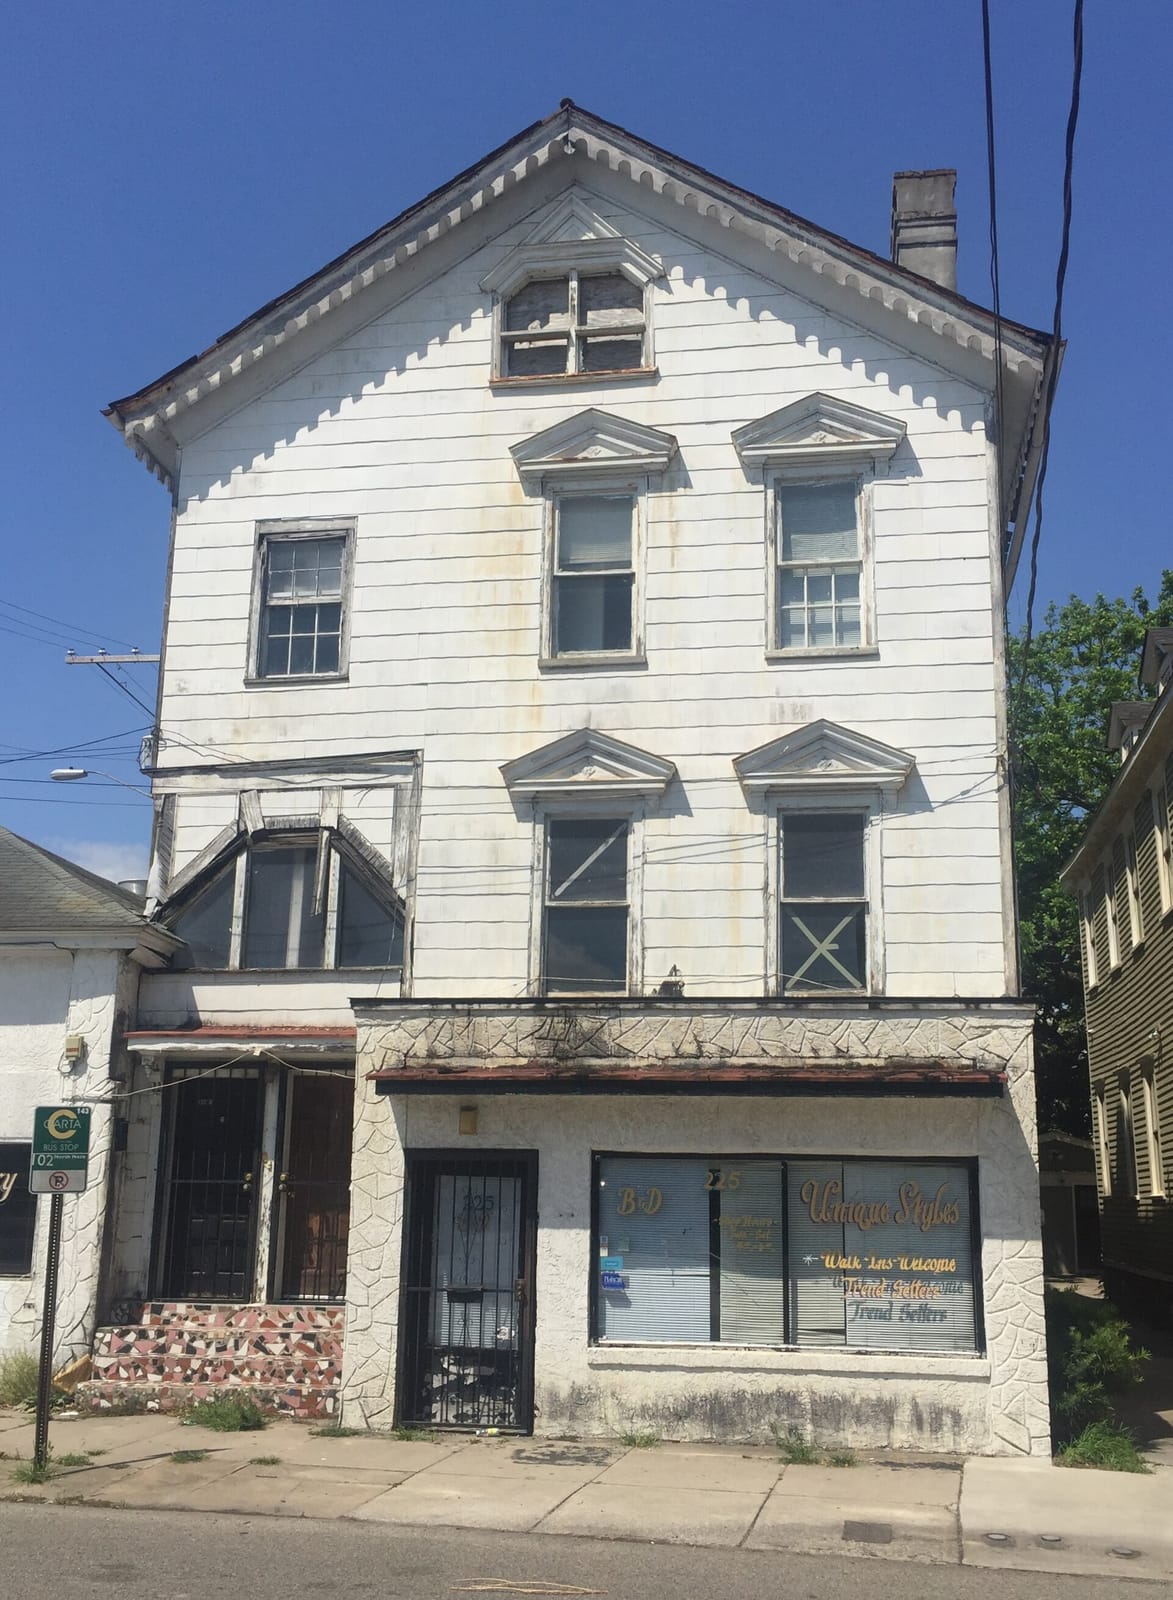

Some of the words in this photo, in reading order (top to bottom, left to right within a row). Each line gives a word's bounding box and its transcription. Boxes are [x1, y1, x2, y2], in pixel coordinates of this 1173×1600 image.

[43, 1143, 58, 1151] BUS
[60, 1143, 80, 1152] STOP
[703, 1170, 741, 1191] 225
[800, 1179, 890, 1231] Unique
[894, 1180, 960, 1232] Styles
[841, 1276, 886, 1299] Trend
[892, 1279, 941, 1299] Setters
